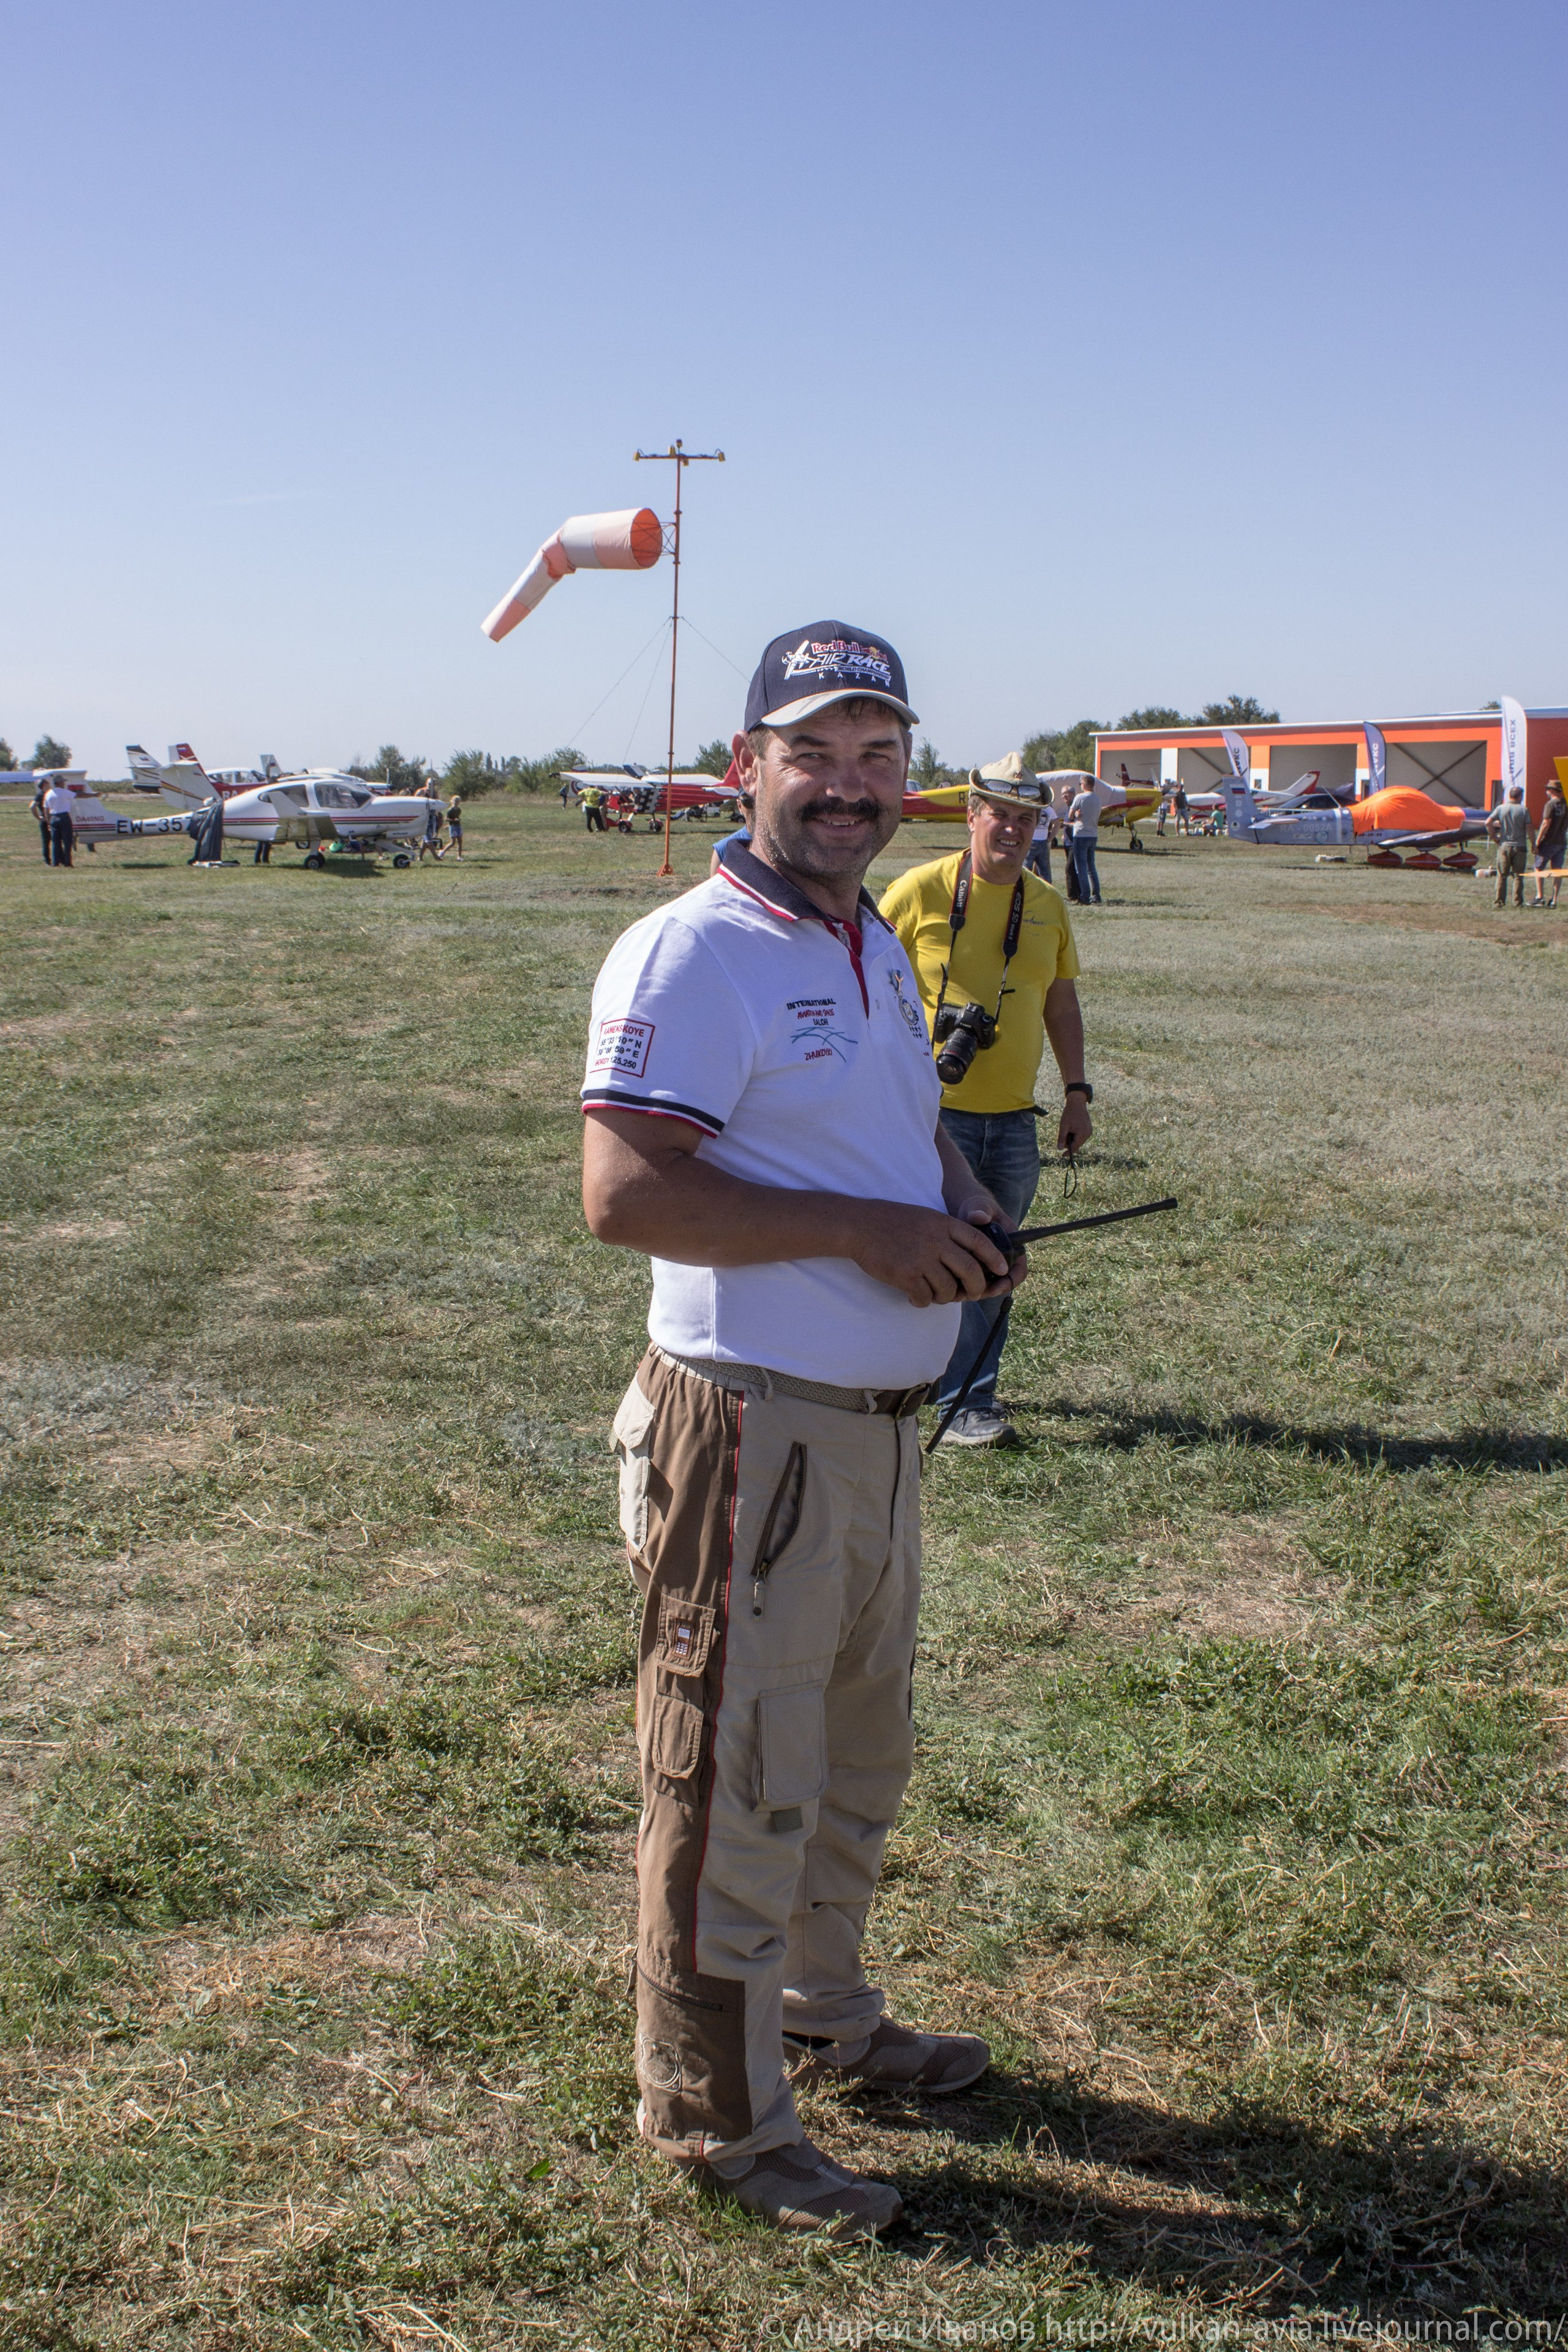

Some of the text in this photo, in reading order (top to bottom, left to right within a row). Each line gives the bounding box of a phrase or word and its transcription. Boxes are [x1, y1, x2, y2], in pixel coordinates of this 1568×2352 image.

[811, 640, 860, 654] Red Bull
[809, 653, 890, 675] AIR RACE
[956, 880, 967, 908] Canon
[1011, 912, 1019, 923] 5D
[786, 998, 836, 1011] INTERNATIONAL
